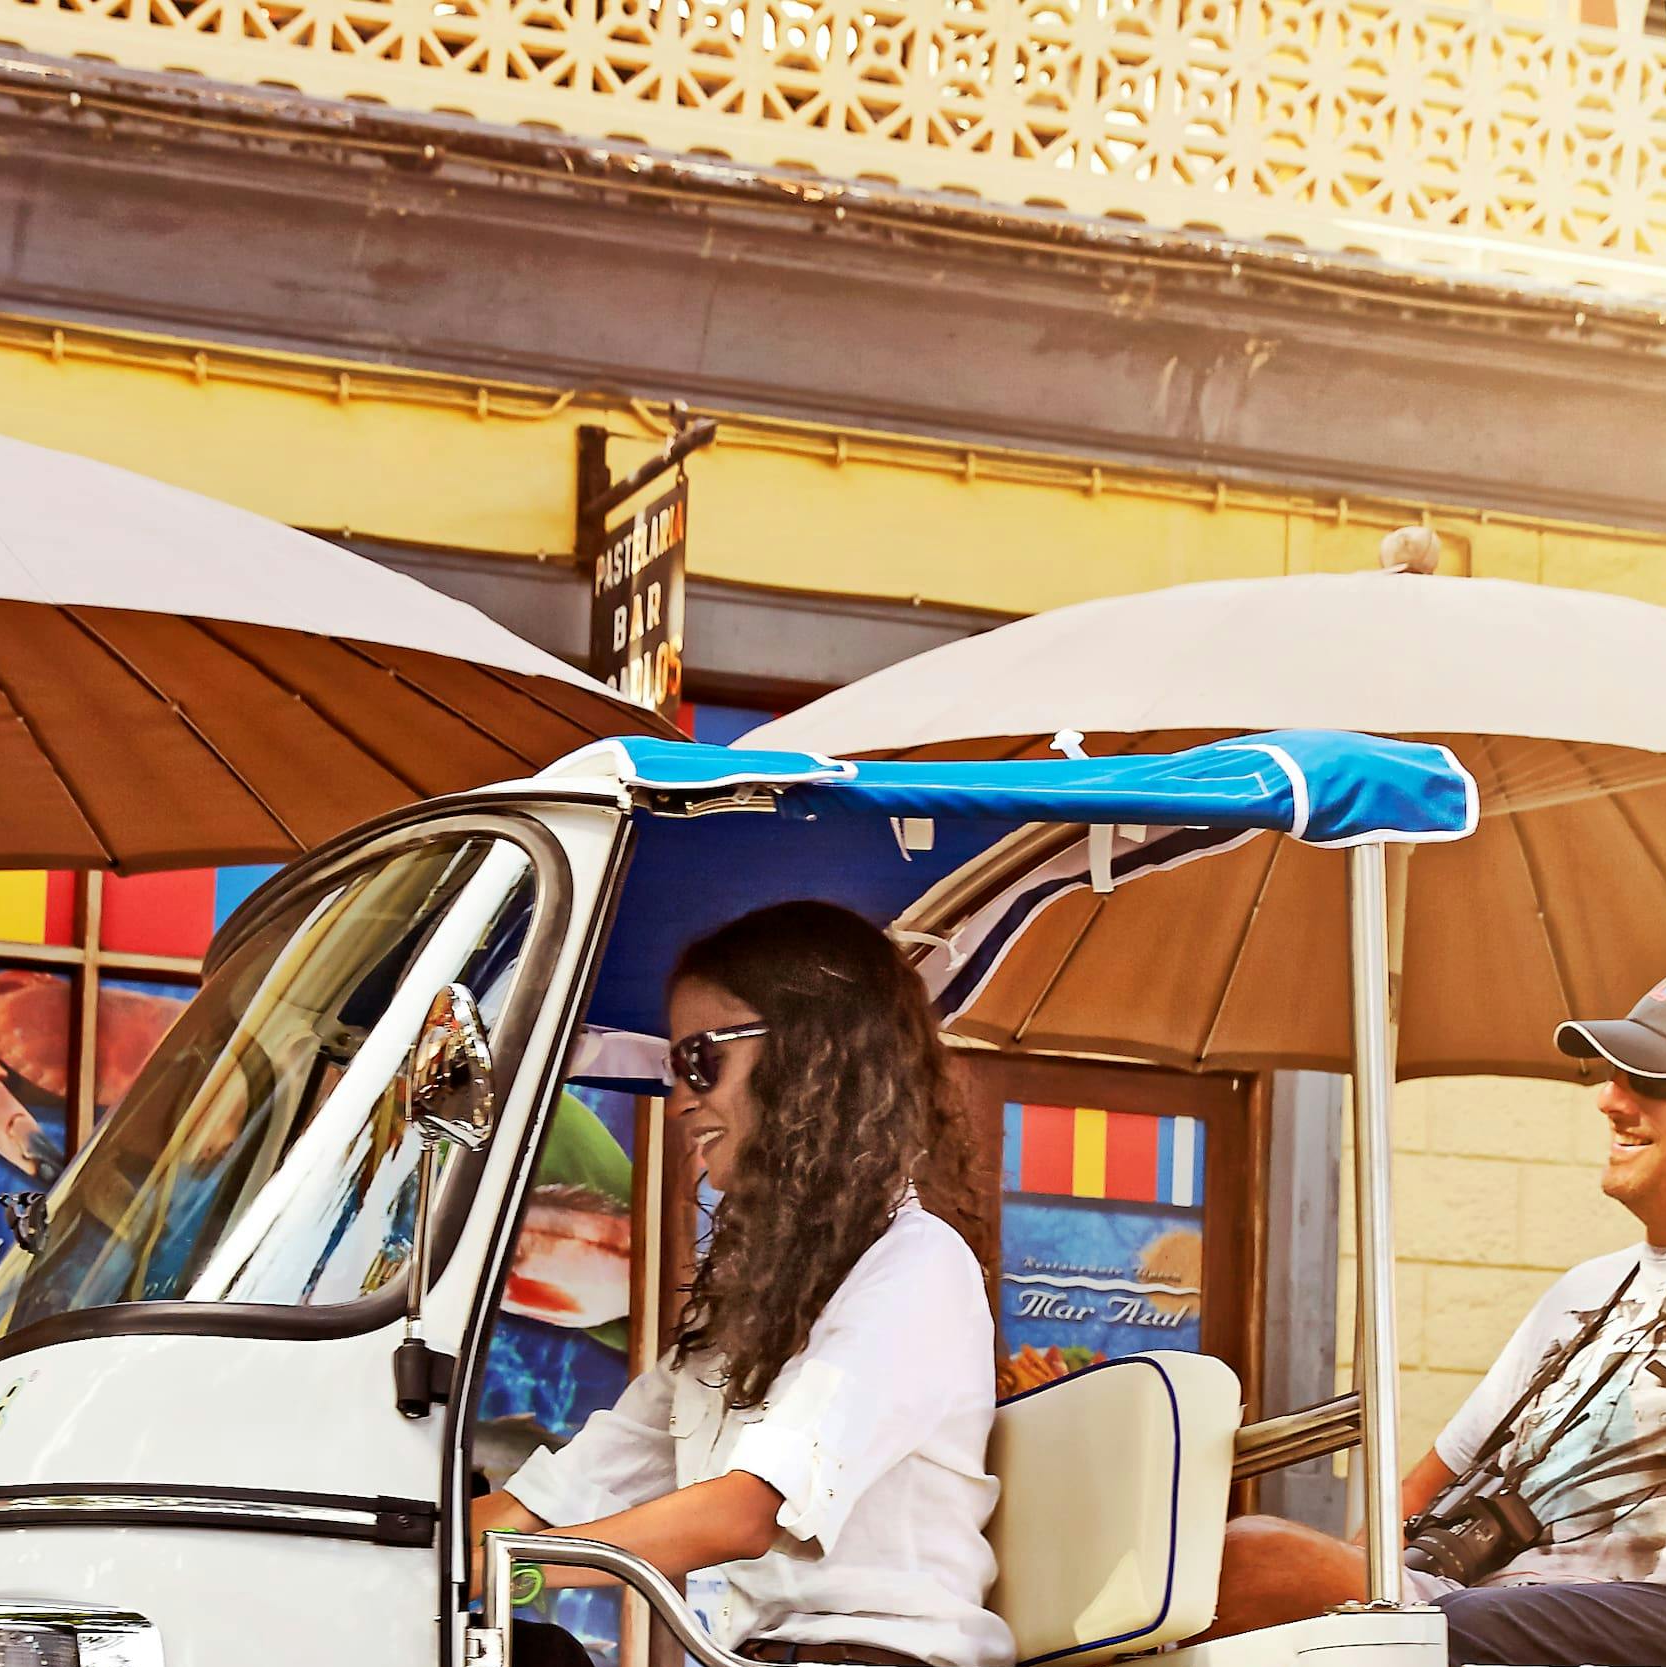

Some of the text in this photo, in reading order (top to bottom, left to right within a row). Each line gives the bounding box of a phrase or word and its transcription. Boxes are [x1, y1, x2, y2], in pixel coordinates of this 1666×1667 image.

[613, 581, 662, 653] BAR
[1010, 1289, 1190, 1329] Mar Azul
